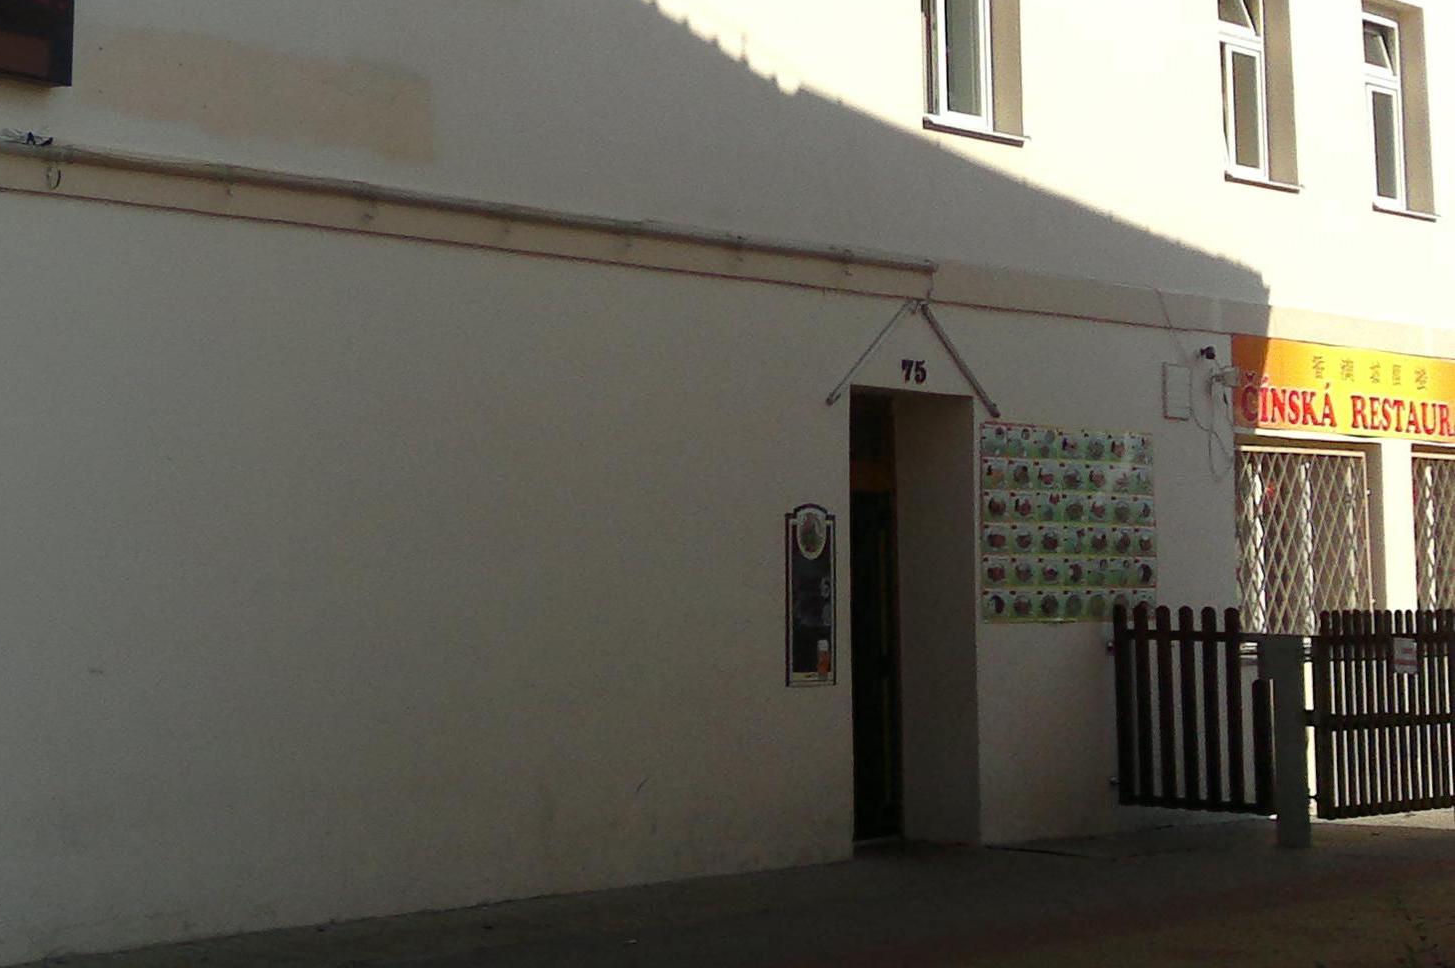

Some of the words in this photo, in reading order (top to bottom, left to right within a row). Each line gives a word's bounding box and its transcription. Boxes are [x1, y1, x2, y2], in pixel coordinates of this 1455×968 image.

[901, 359, 927, 384] 75
[1241, 372, 1337, 428] ČÍNSKÁ
[1350, 395, 1455, 437] RESTAUR
